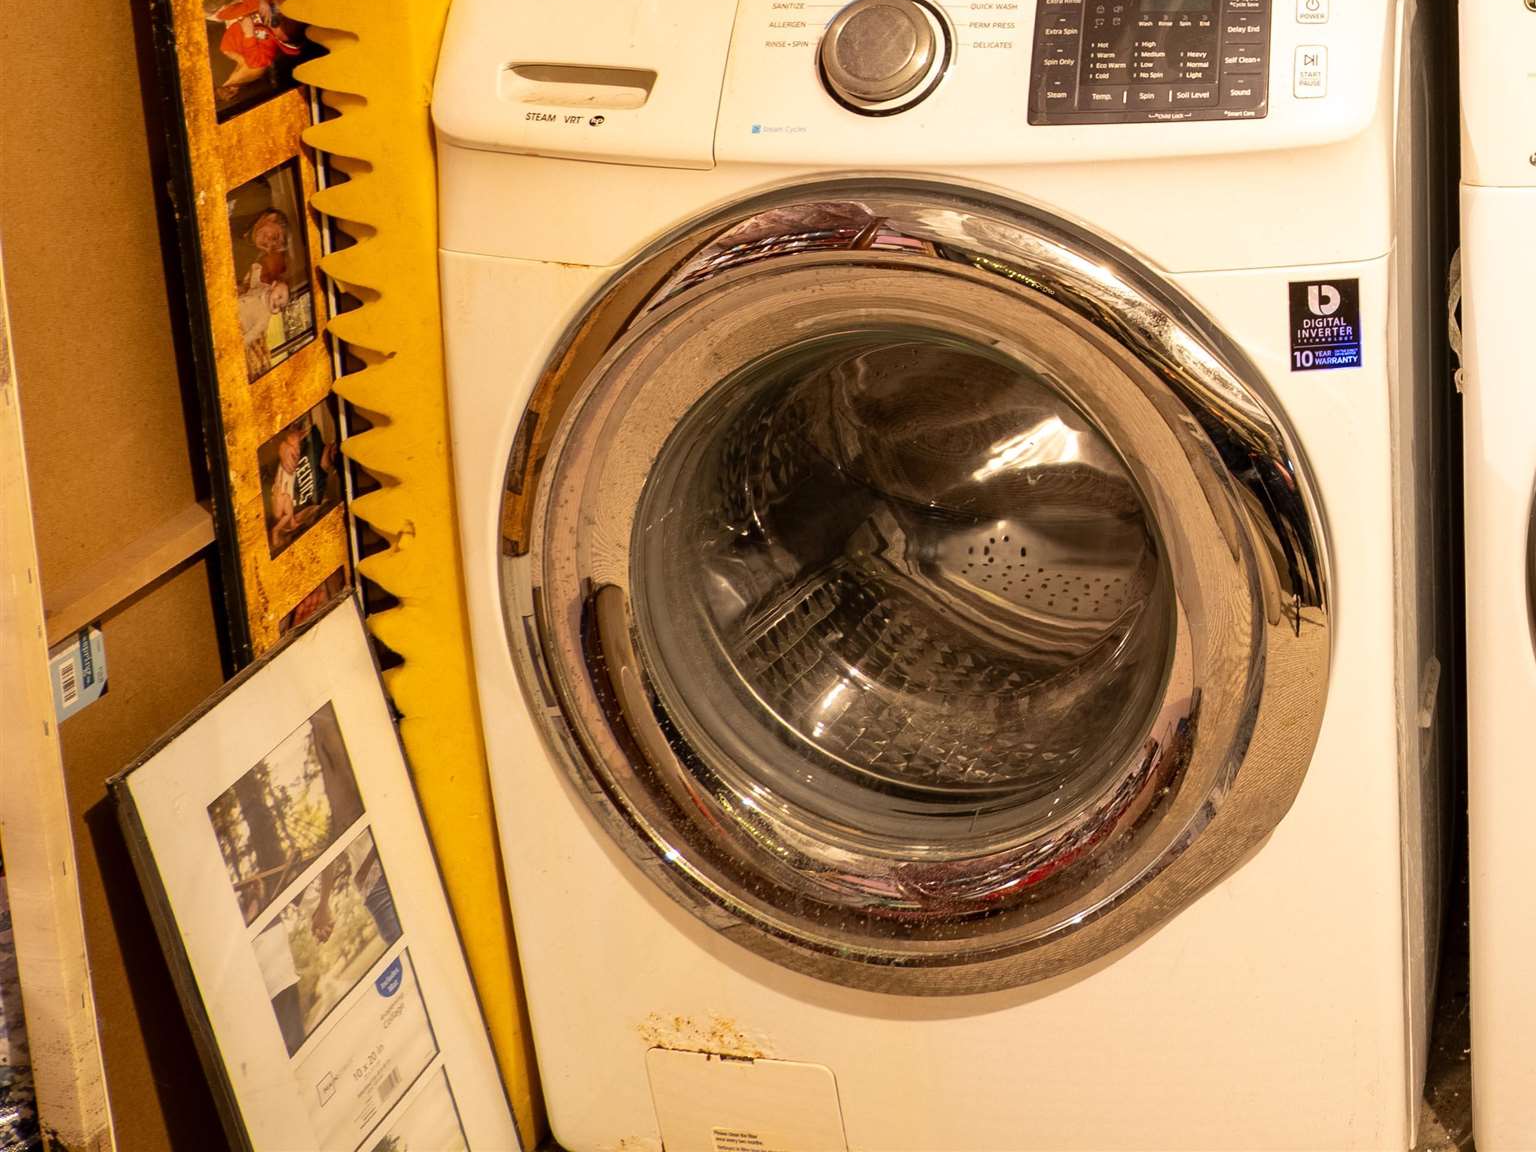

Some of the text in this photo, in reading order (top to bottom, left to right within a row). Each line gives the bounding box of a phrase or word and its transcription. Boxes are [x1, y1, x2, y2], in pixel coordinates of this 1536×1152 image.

[1045, 28, 1063, 36] Extra
[1227, 26, 1246, 34] Delay
[1043, 58, 1075, 66] Spin Only
[1224, 56, 1238, 64] Self
[1047, 91, 1067, 99] Steam
[1139, 92, 1155, 100] Spin
[1191, 91, 1210, 99] Level
[1230, 88, 1251, 97] Sound
[525, 112, 556, 122] STEAM
[1303, 317, 1347, 328] DIGITAL
[1297, 326, 1353, 338] INVERTER
[1293, 350, 1314, 368] 10
[1315, 355, 1358, 365] WARRANTY
